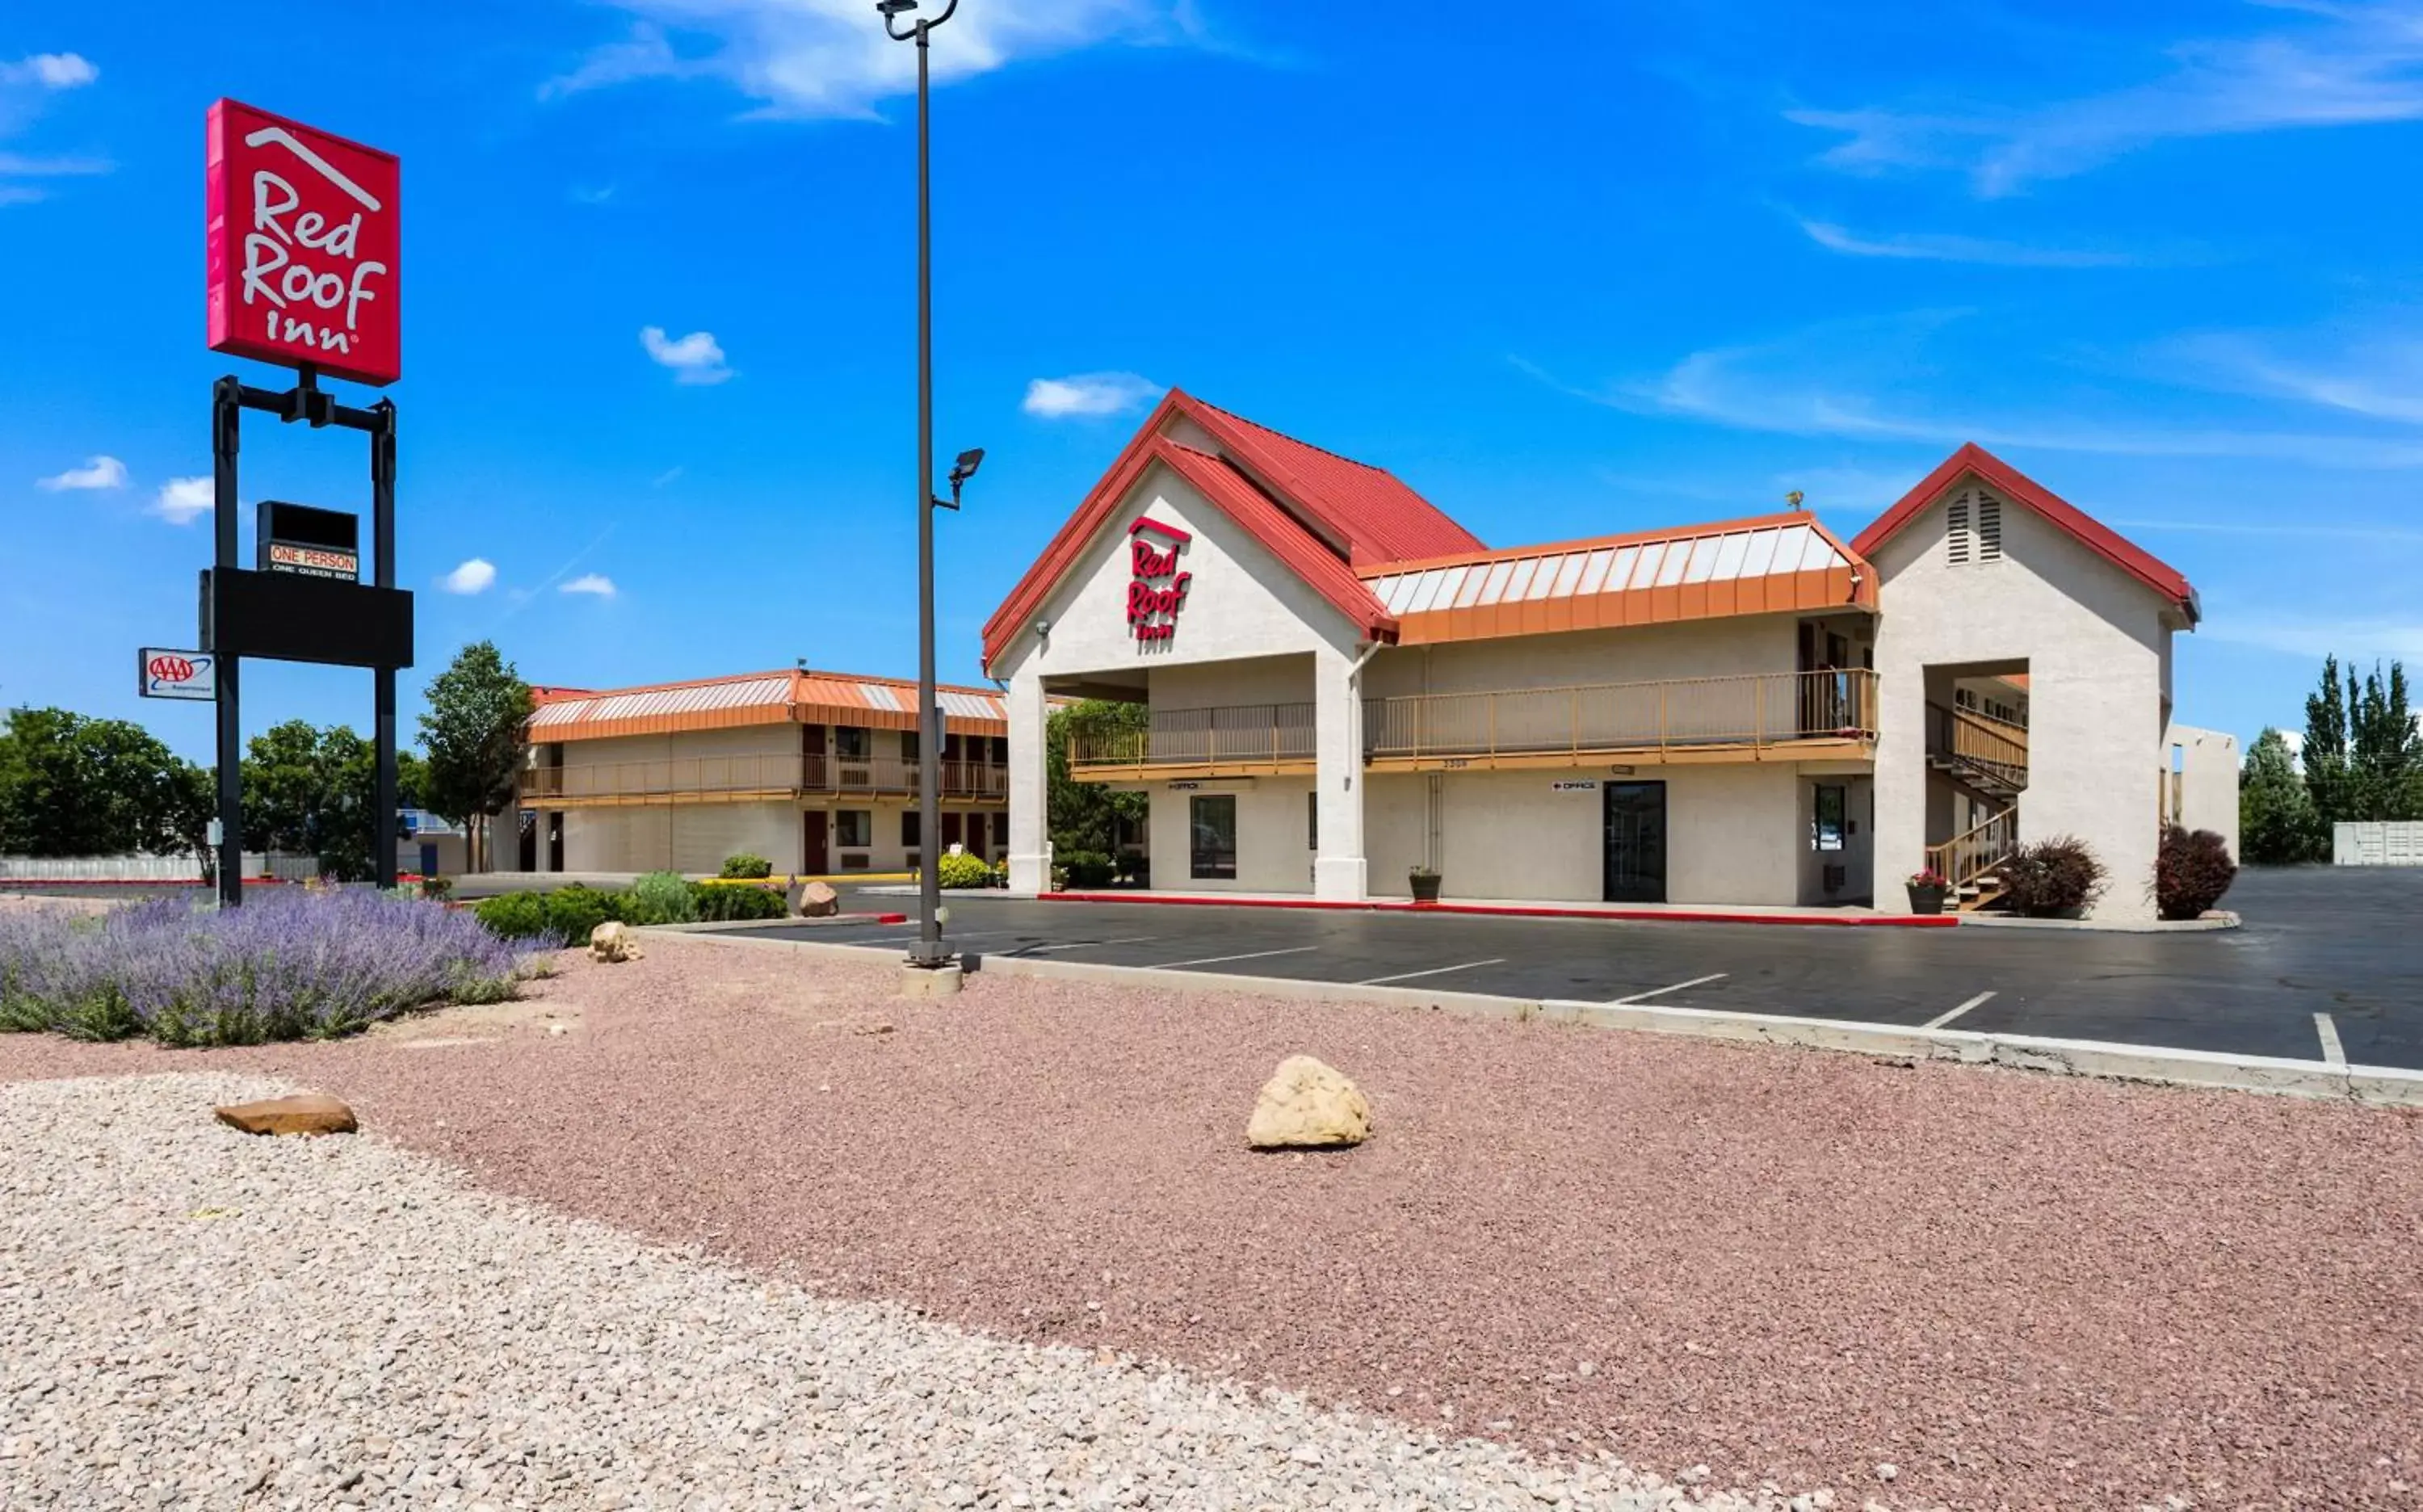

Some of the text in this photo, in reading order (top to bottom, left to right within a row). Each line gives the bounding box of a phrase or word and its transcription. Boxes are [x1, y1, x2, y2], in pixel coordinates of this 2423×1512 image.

[253, 170, 361, 258] Red
[241, 233, 387, 329] Roof
[272, 547, 354, 569] ONE PERSON
[272, 564, 355, 581] ONE QUEEN BED
[1132, 541, 1179, 578] Red
[1128, 572, 1191, 624] Roof
[154, 657, 189, 682] AAA
